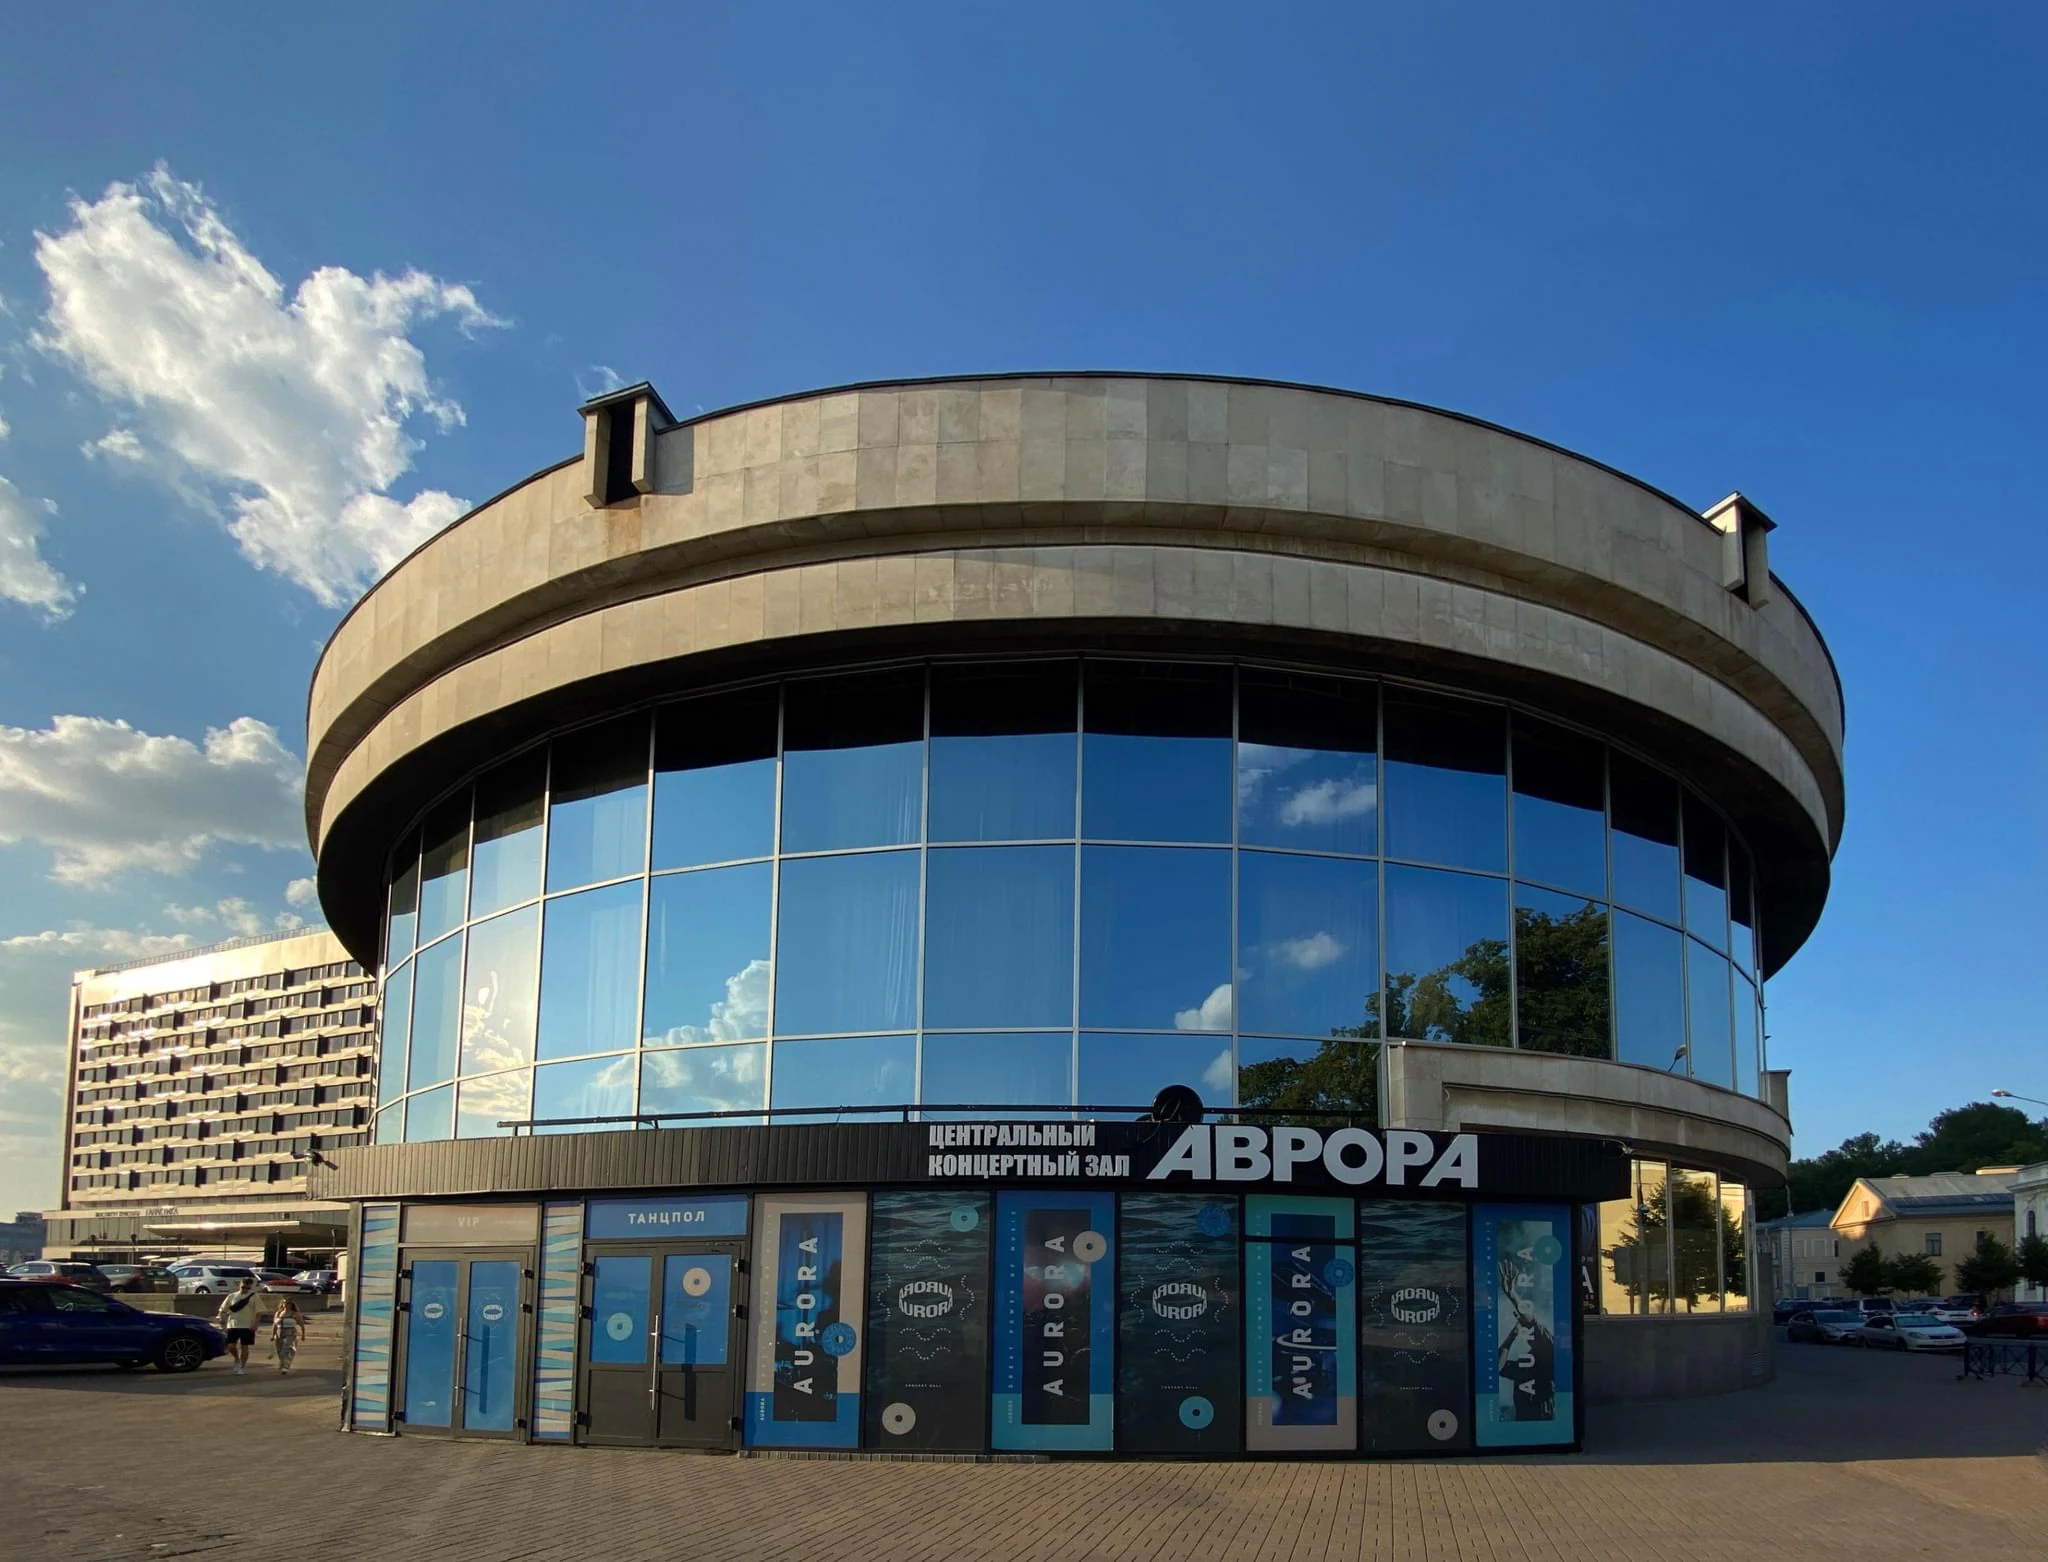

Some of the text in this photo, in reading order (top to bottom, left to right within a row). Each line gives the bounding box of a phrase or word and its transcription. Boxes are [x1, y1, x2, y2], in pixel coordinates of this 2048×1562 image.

[928, 1150, 1130, 1179] КОНЦЕРТНЫЙ ЗАЛ
[929, 1123, 1096, 1149] ЦЕНТРАЛЬНЫЙ
[1145, 1124, 1479, 1188] АВРОРА
[457, 1216, 480, 1227] VIP
[628, 1210, 705, 1225] ТАНЦПОЛ
[794, 1236, 819, 1395] AURORA
[1043, 1235, 1065, 1396] AURORA
[1291, 1246, 1313, 1400] AURORA
[1517, 1246, 1536, 1396] AURORA
